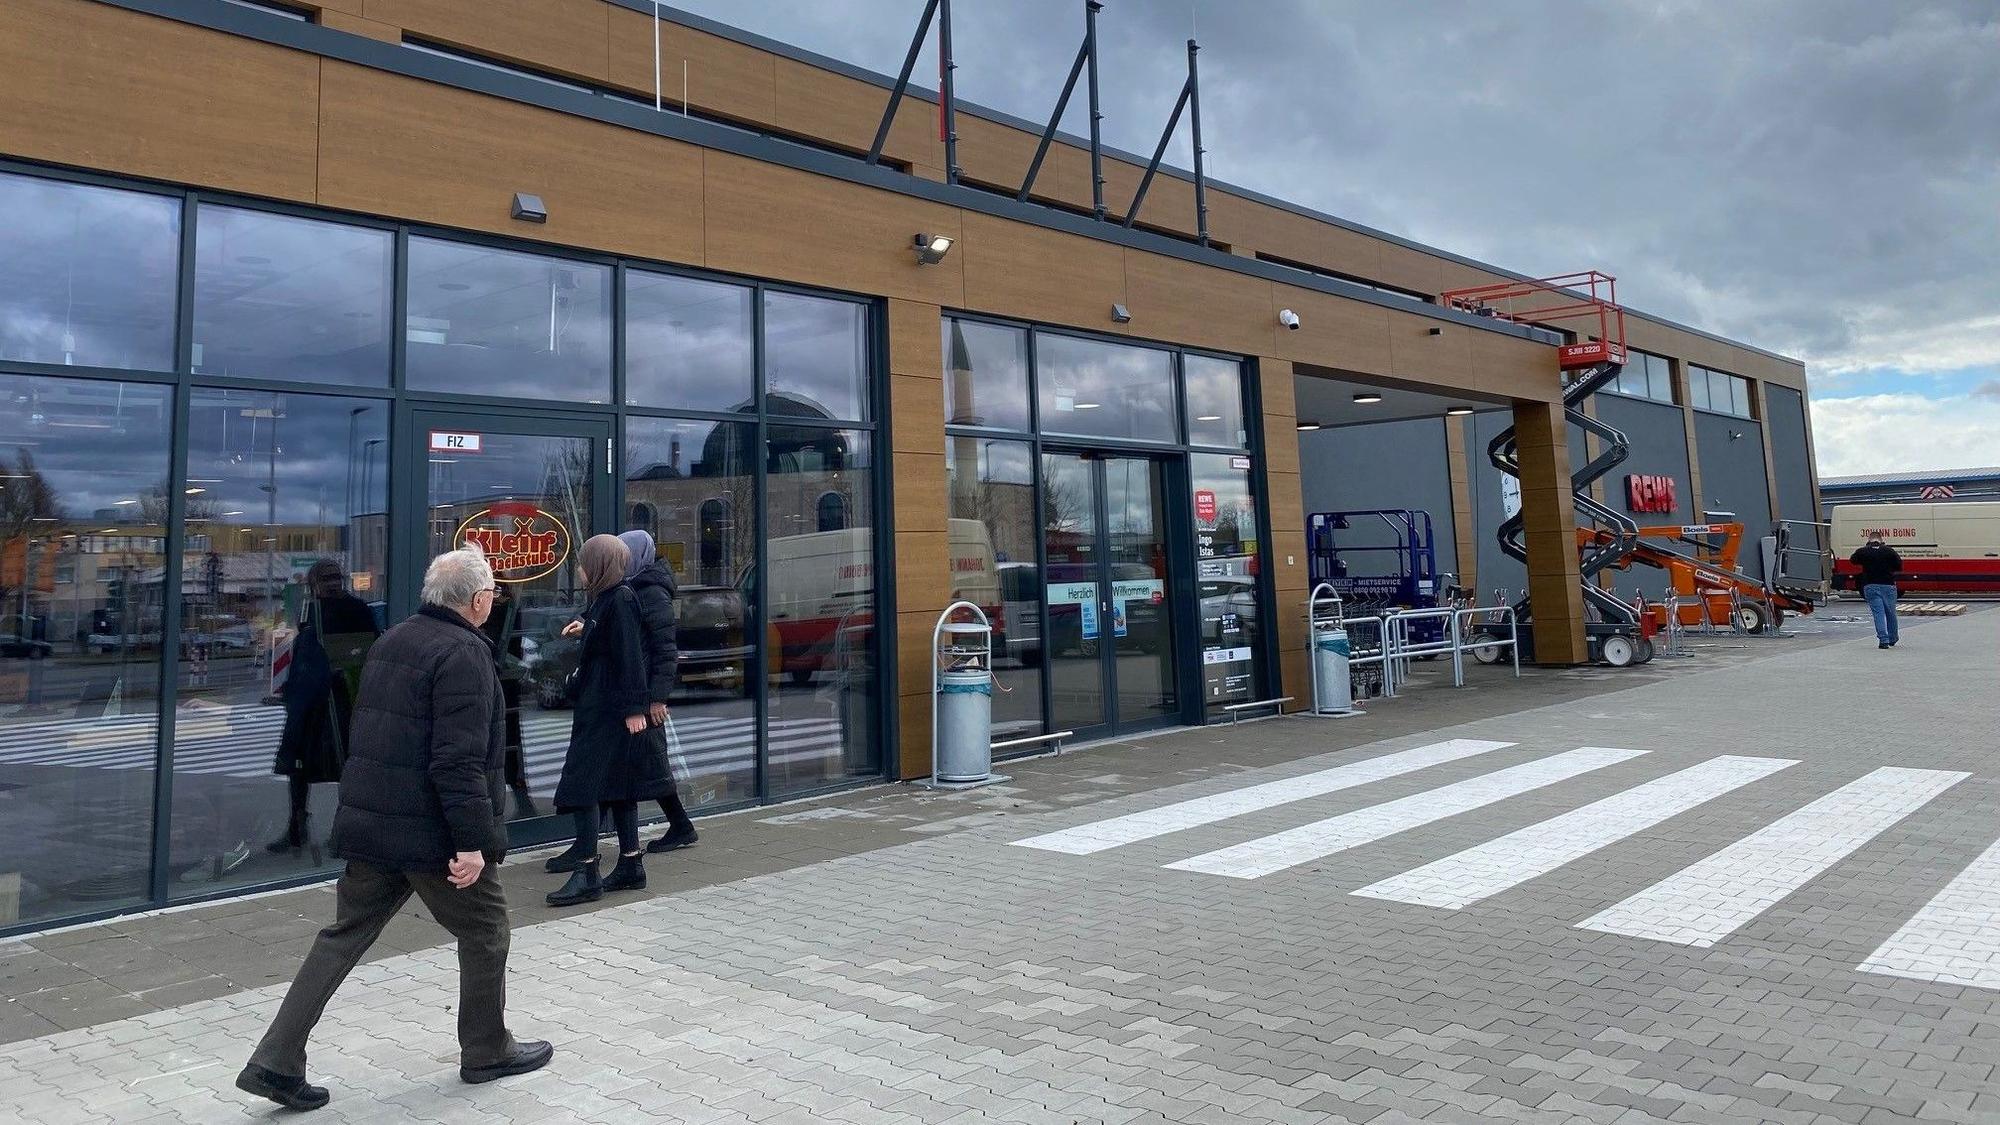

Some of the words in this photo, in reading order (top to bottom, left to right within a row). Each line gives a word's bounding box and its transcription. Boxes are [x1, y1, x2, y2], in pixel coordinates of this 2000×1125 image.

[1584, 345, 1601, 354] 3220
[446, 435, 464, 448] FIZ
[1631, 474, 1678, 513] REWE
[1683, 526, 1709, 534] Boels
[1198, 534, 1213, 547] Ingo
[1199, 546, 1214, 556] Istas
[488, 550, 556, 572] Backstube
[1068, 588, 1094, 600] Herzlich
[1113, 585, 1150, 597] Willkommen
